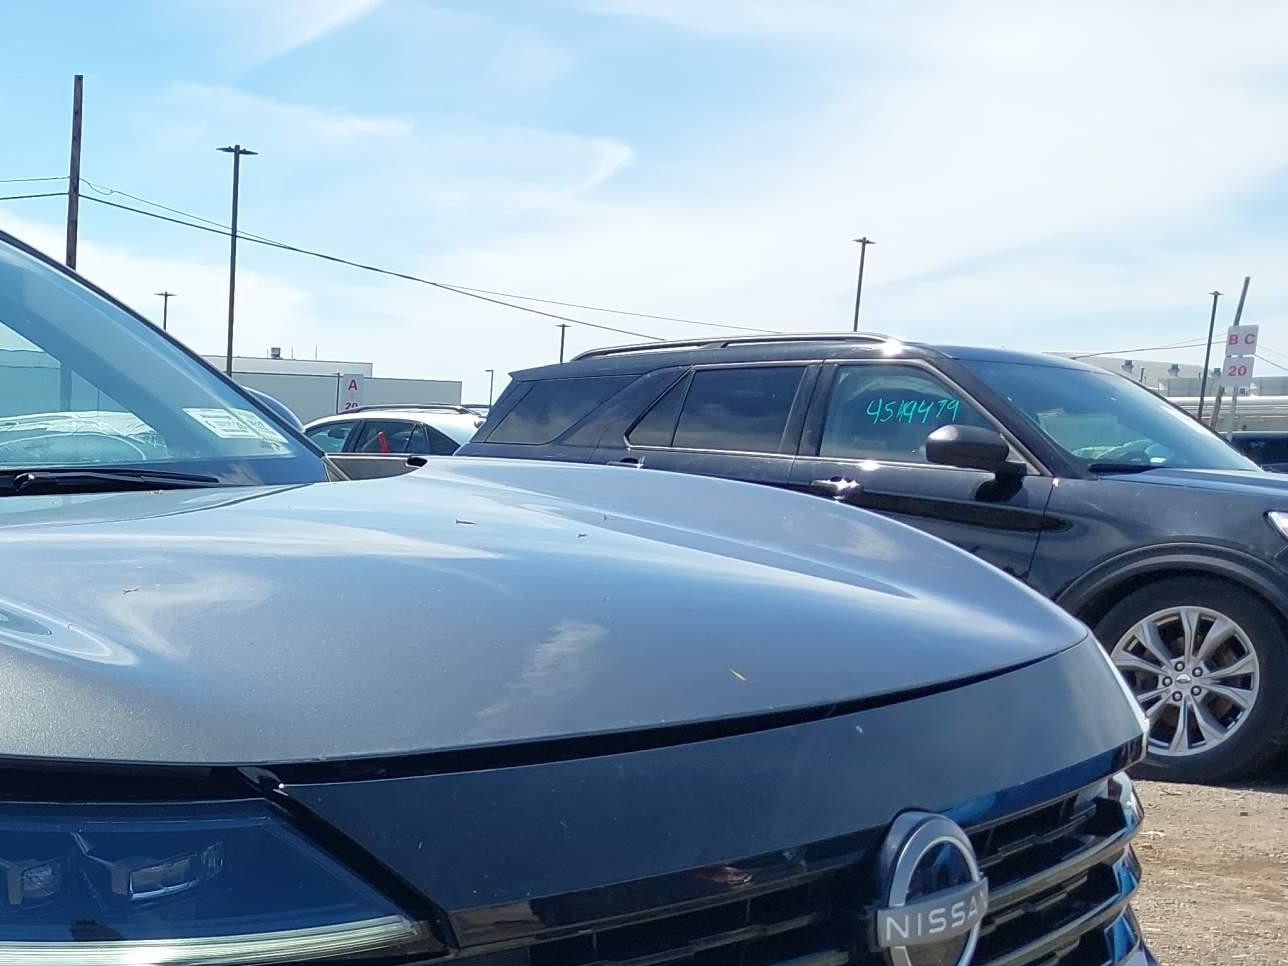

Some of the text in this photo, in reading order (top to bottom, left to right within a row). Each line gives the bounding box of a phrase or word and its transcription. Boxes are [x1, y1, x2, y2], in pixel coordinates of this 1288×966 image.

[1229, 333, 1256, 346] B C
[1227, 365, 1247, 377] 20
[348, 379, 358, 391] A
